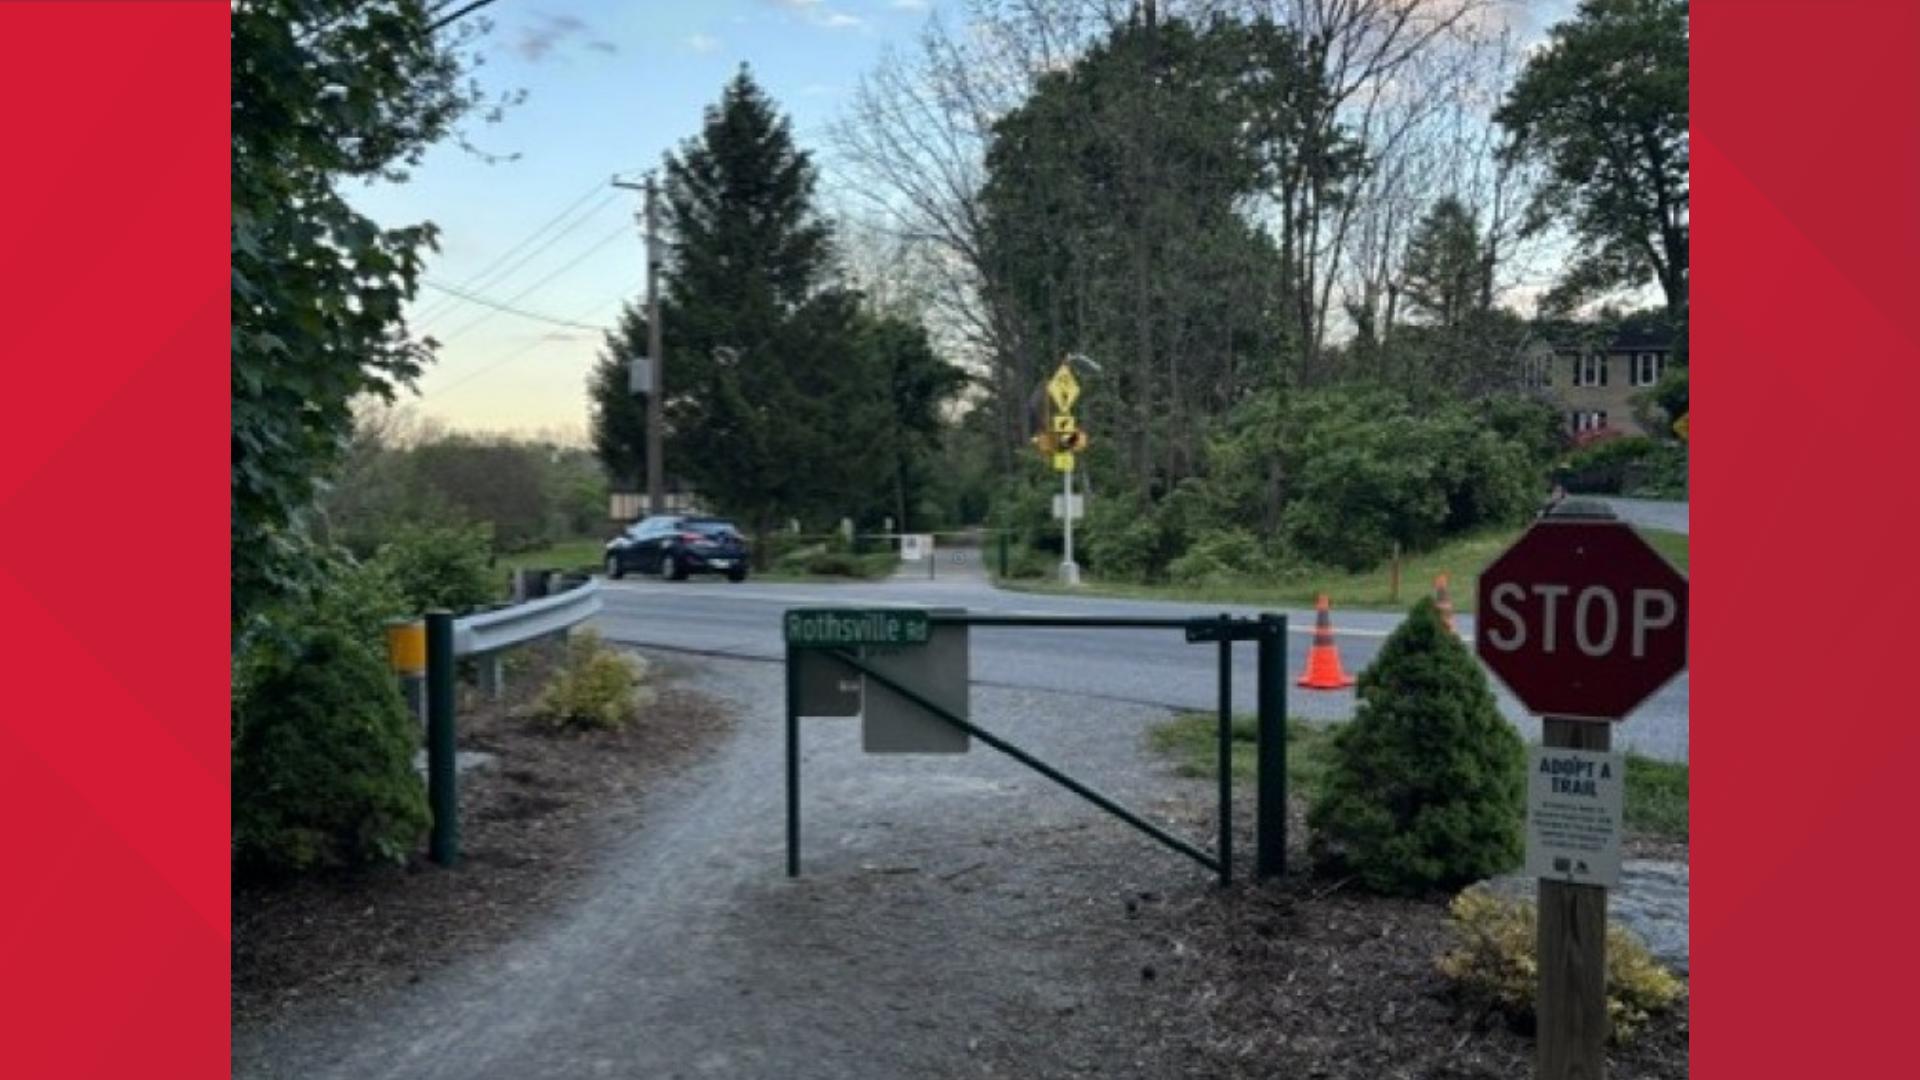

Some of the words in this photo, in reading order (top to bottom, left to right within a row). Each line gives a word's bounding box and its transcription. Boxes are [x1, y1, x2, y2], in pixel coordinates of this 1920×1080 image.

[788, 614, 900, 642] Rothsville
[906, 620, 927, 642] Rd
[1487, 582, 1677, 657] STOP
[1540, 757, 1594, 778] ADOPT
[1601, 761, 1611, 779] A
[1551, 776, 1597, 798] TRAIL
